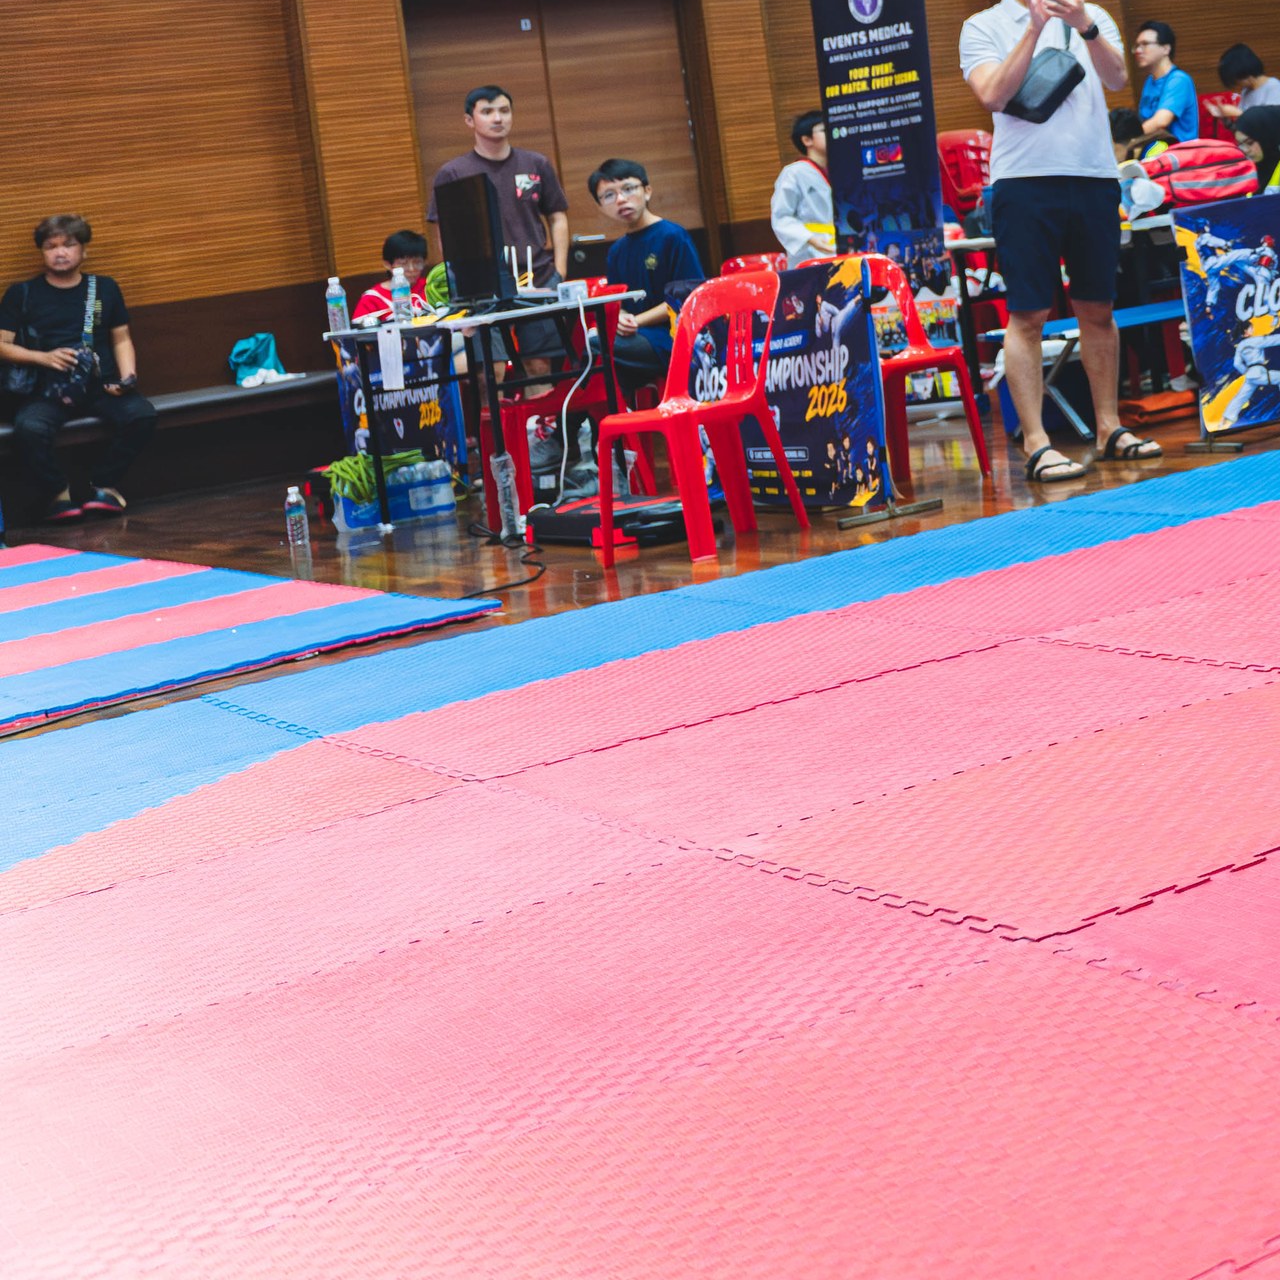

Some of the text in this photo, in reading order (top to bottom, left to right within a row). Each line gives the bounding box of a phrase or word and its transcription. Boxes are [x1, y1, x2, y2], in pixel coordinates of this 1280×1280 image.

[823, 21, 914, 51] EVENTS MEDICAL
[829, 48, 873, 64] AMBULANCE
[849, 66, 870, 80] YOUR
[825, 84, 840, 98] OUR
[695, 344, 850, 401] CLOS AMPIONSHIP
[805, 376, 848, 422] 2026
